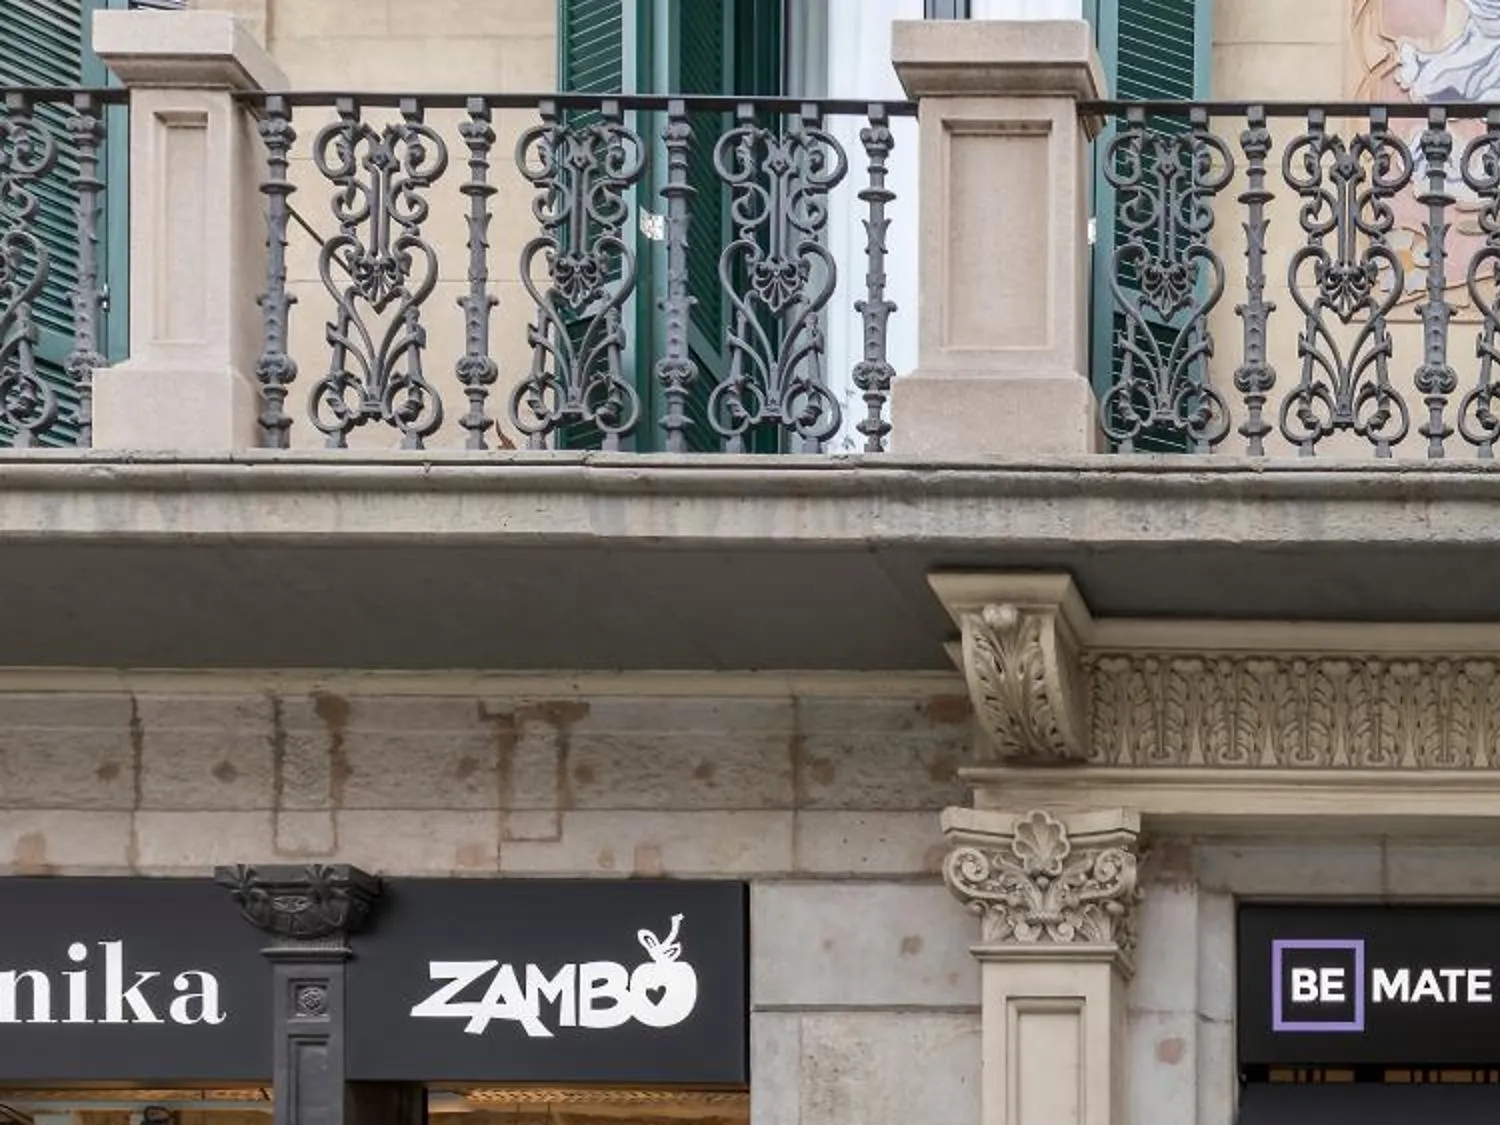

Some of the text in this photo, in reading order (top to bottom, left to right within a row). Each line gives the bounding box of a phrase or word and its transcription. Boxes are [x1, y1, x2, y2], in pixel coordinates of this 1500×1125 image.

[0, 939, 227, 1025] nika
[409, 959, 698, 1037] ZAMBO
[1291, 967, 1346, 1003] BE
[1371, 967, 1493, 1003] MATE
